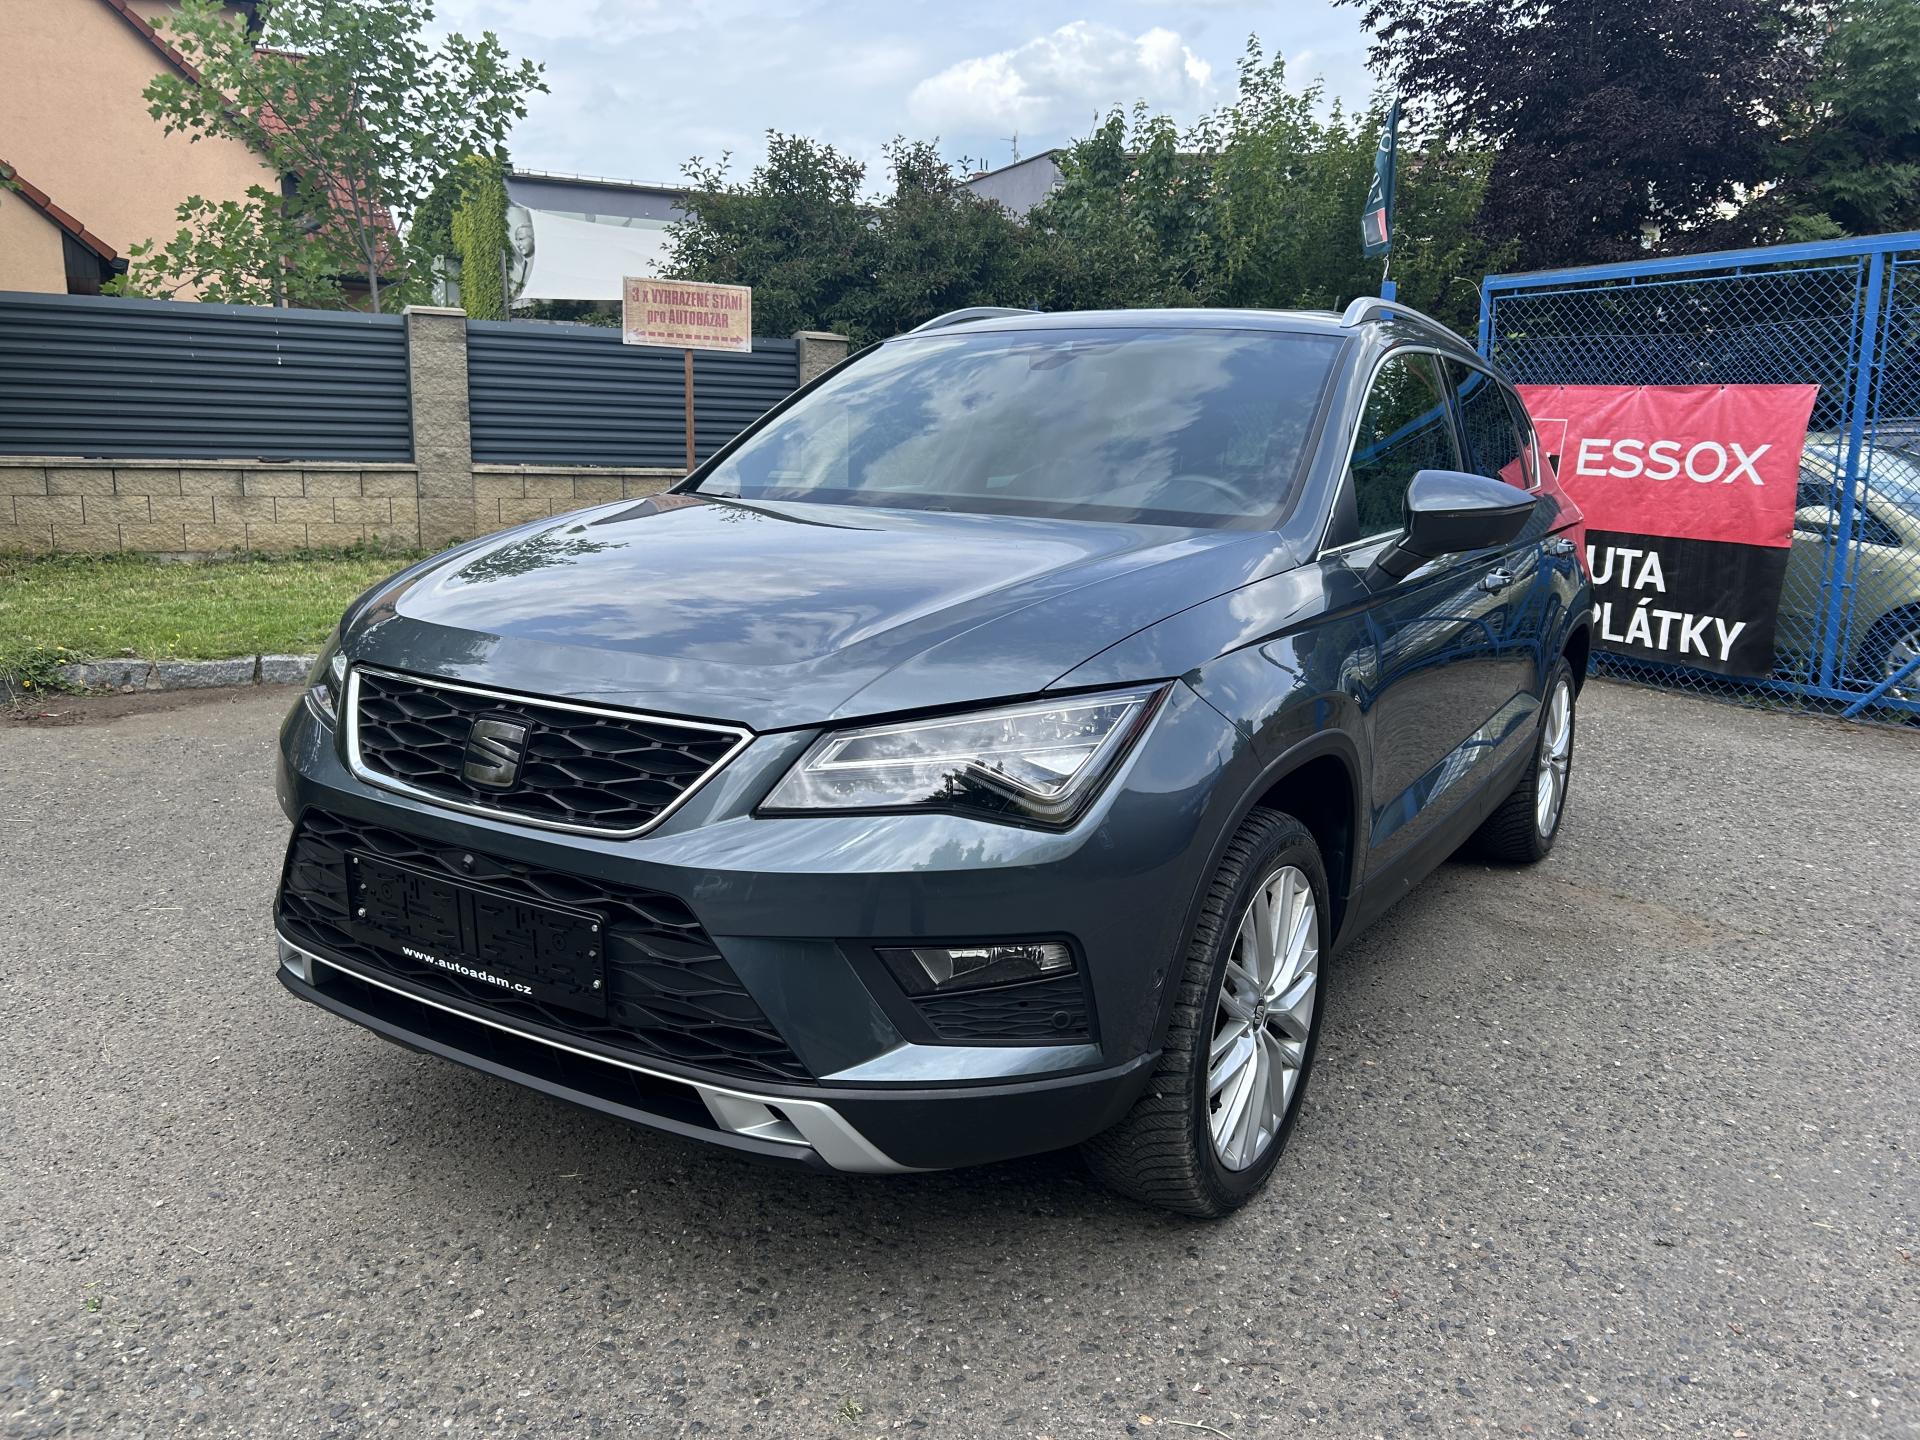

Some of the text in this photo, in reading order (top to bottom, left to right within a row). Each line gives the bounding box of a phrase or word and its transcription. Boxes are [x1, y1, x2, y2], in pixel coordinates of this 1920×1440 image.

[632, 287, 639, 302] 3
[652, 289, 709, 308] VYHRAZENÉ
[713, 292, 742, 310] STÁNÍ
[647, 310, 728, 328] pro AUTOBAZAR
[1576, 438, 1772, 486] ESSOX
[402, 946, 533, 994] www.autoadam.cz
